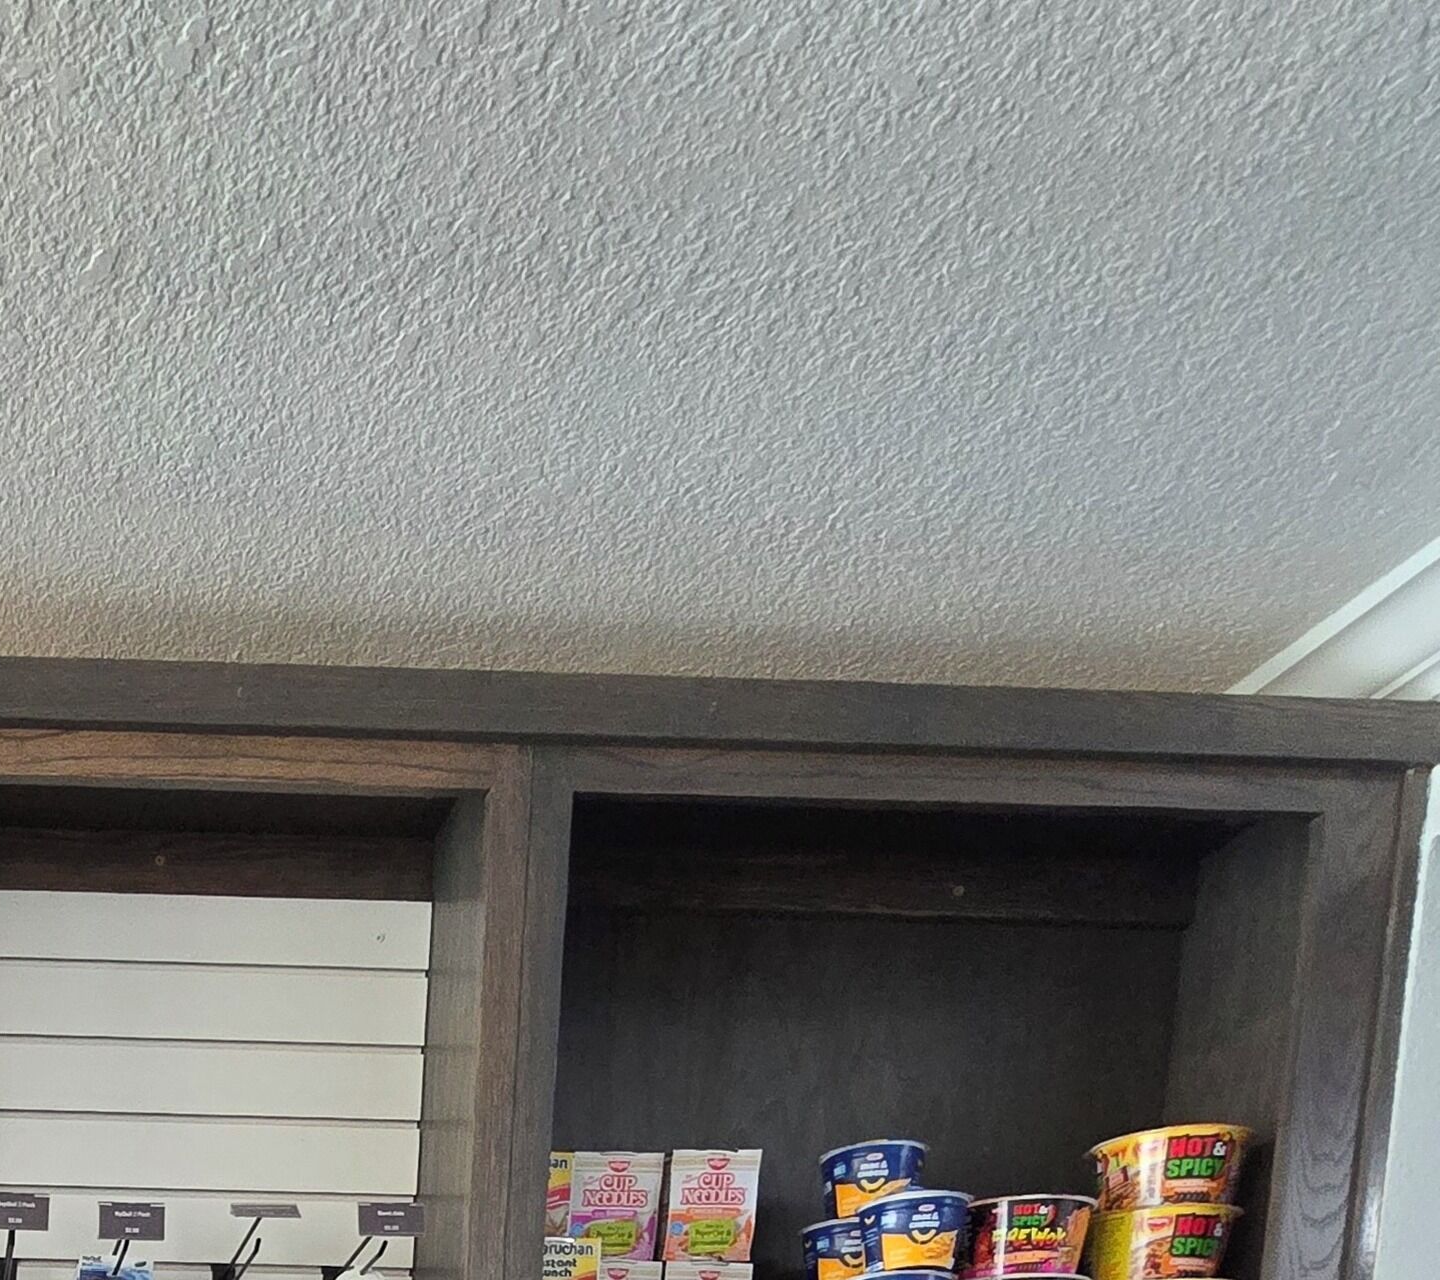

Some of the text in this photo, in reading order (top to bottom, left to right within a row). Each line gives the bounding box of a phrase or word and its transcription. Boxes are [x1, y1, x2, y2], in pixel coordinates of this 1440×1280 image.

[1166, 1158, 1224, 1179] SPICY
[600, 1175, 637, 1191] CUP
[698, 1172, 735, 1189] CUP
[582, 1189, 648, 1208] NOODLES
[681, 1187, 746, 1206] NOODLES
[544, 1268, 572, 1277] unch
